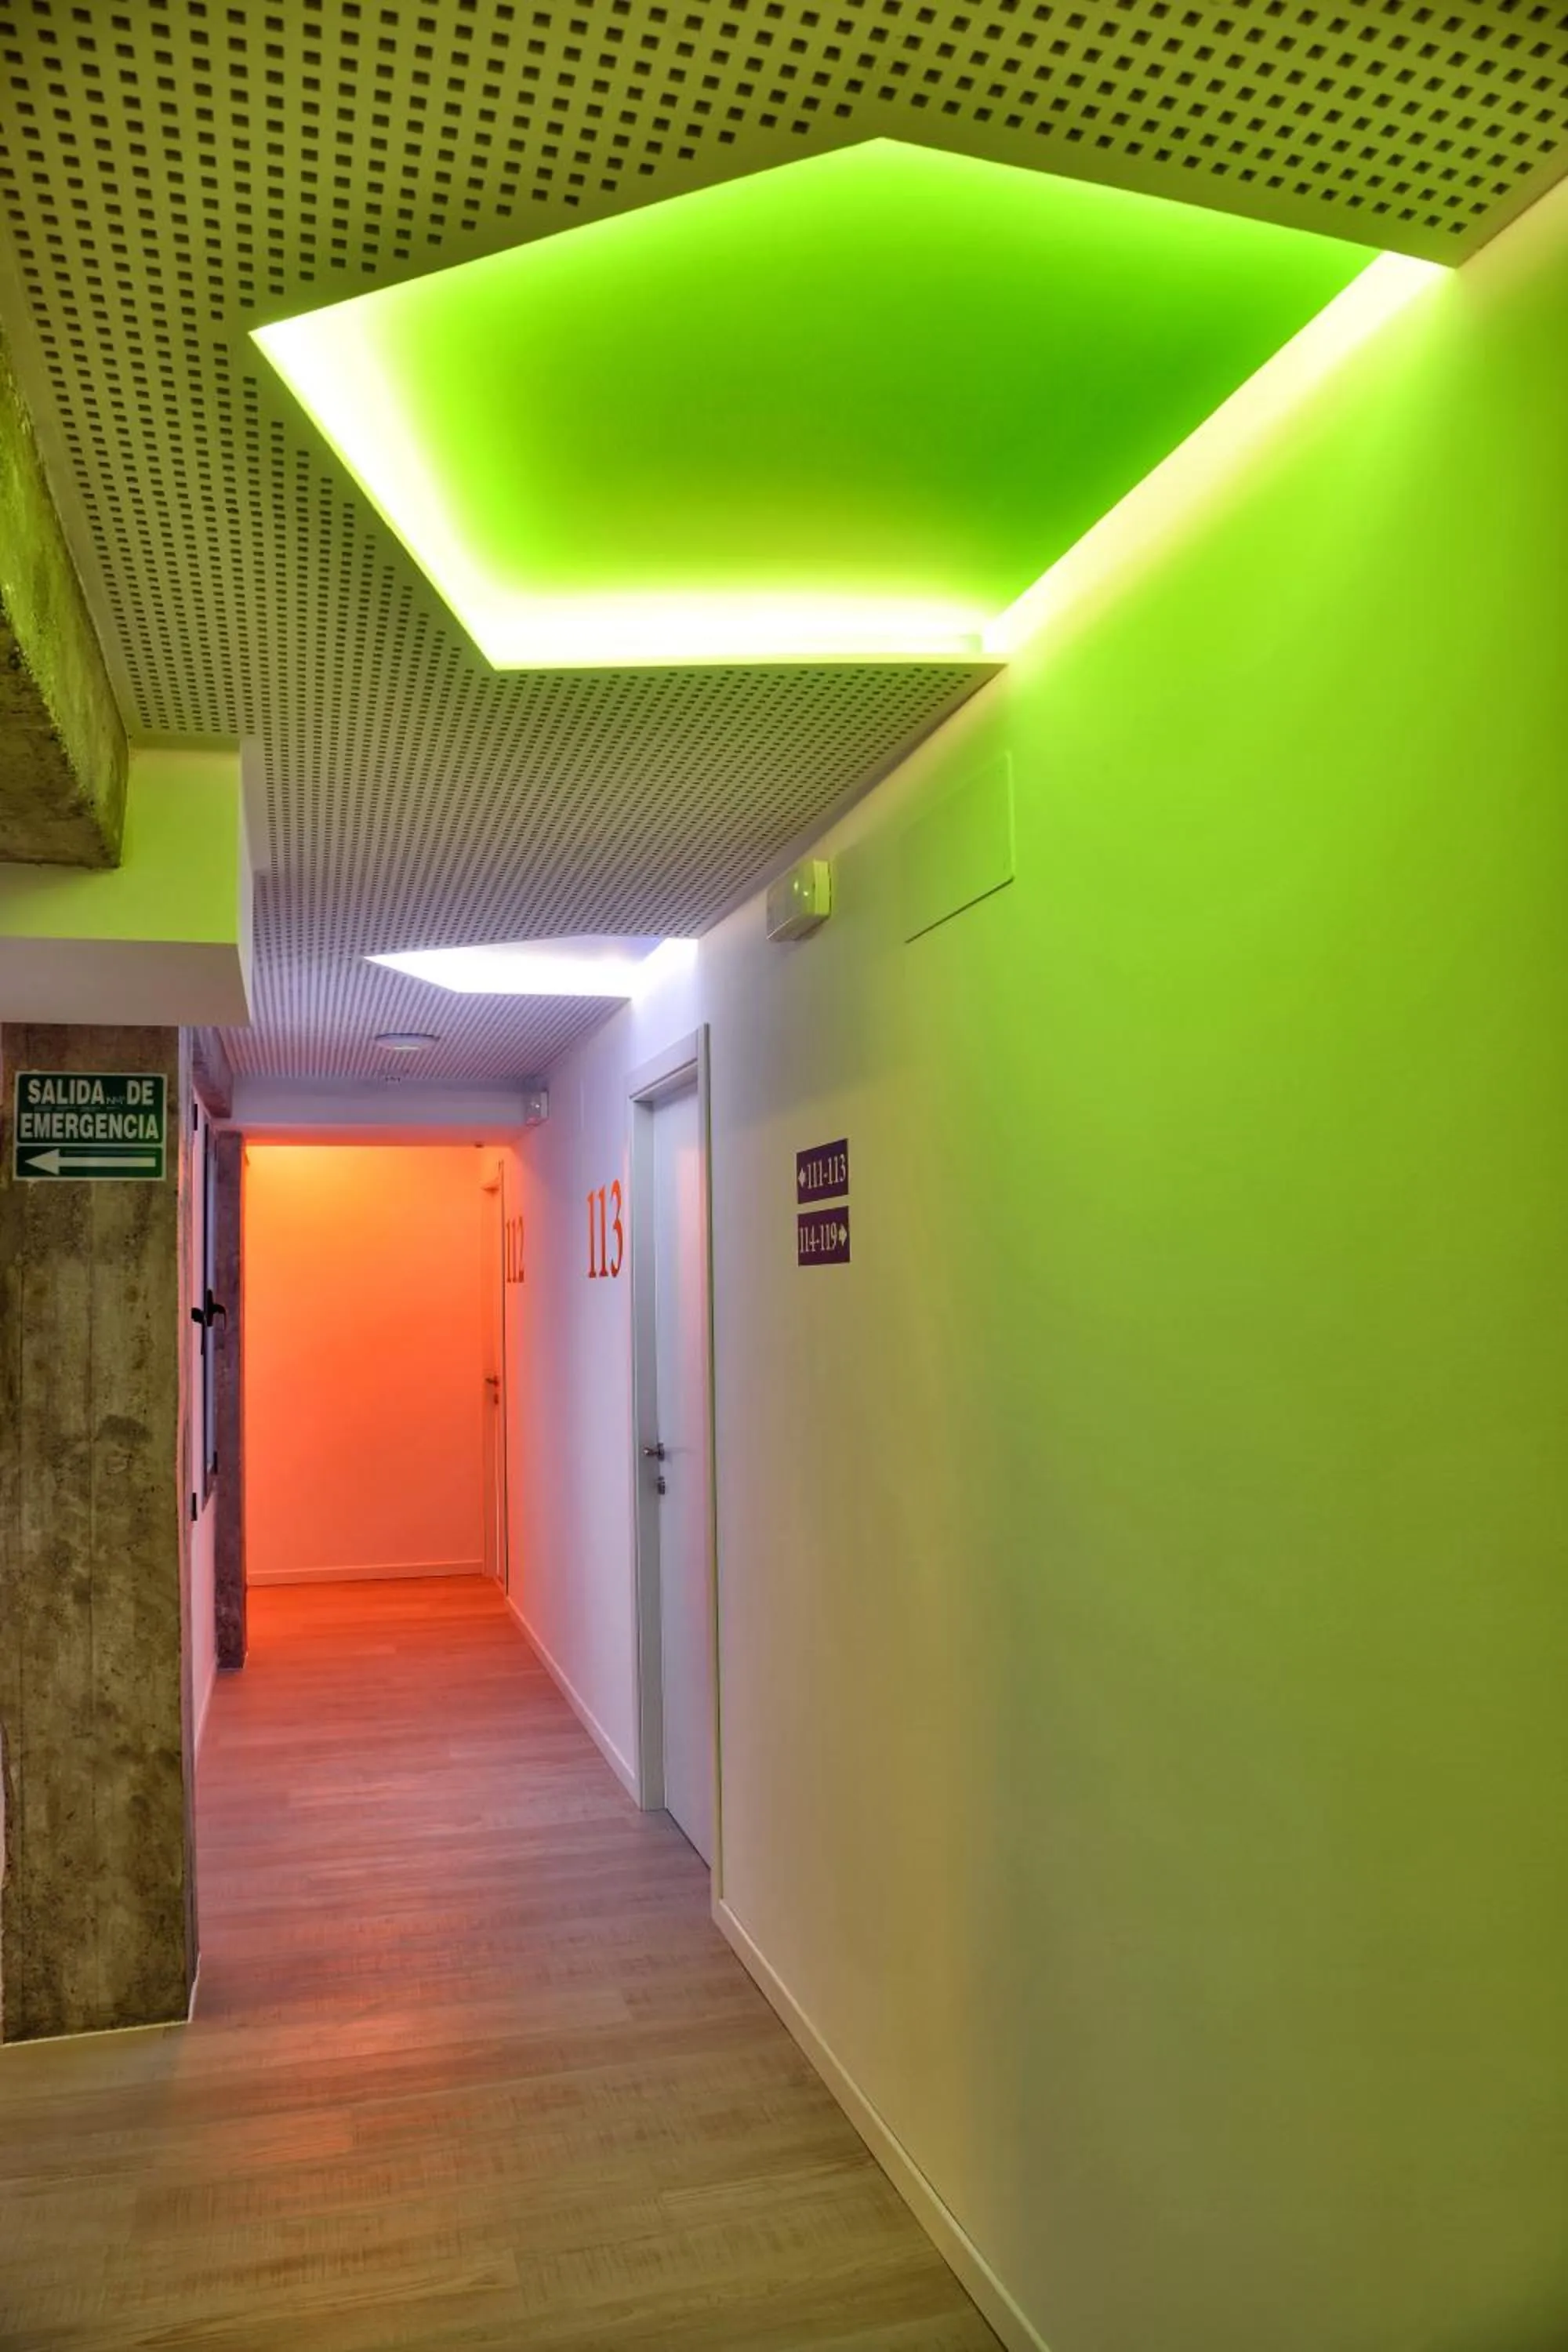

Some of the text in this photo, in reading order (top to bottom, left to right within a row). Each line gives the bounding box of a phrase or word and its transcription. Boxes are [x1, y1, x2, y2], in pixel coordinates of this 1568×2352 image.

[27, 1079, 154, 1105] SALIDA DE
[20, 1112, 159, 1139] EMERGENCIA
[808, 1153, 846, 1189] 111-113
[587, 1179, 623, 1278] 113
[800, 1221, 838, 1253] 114-119
[506, 1216, 524, 1283] 112
